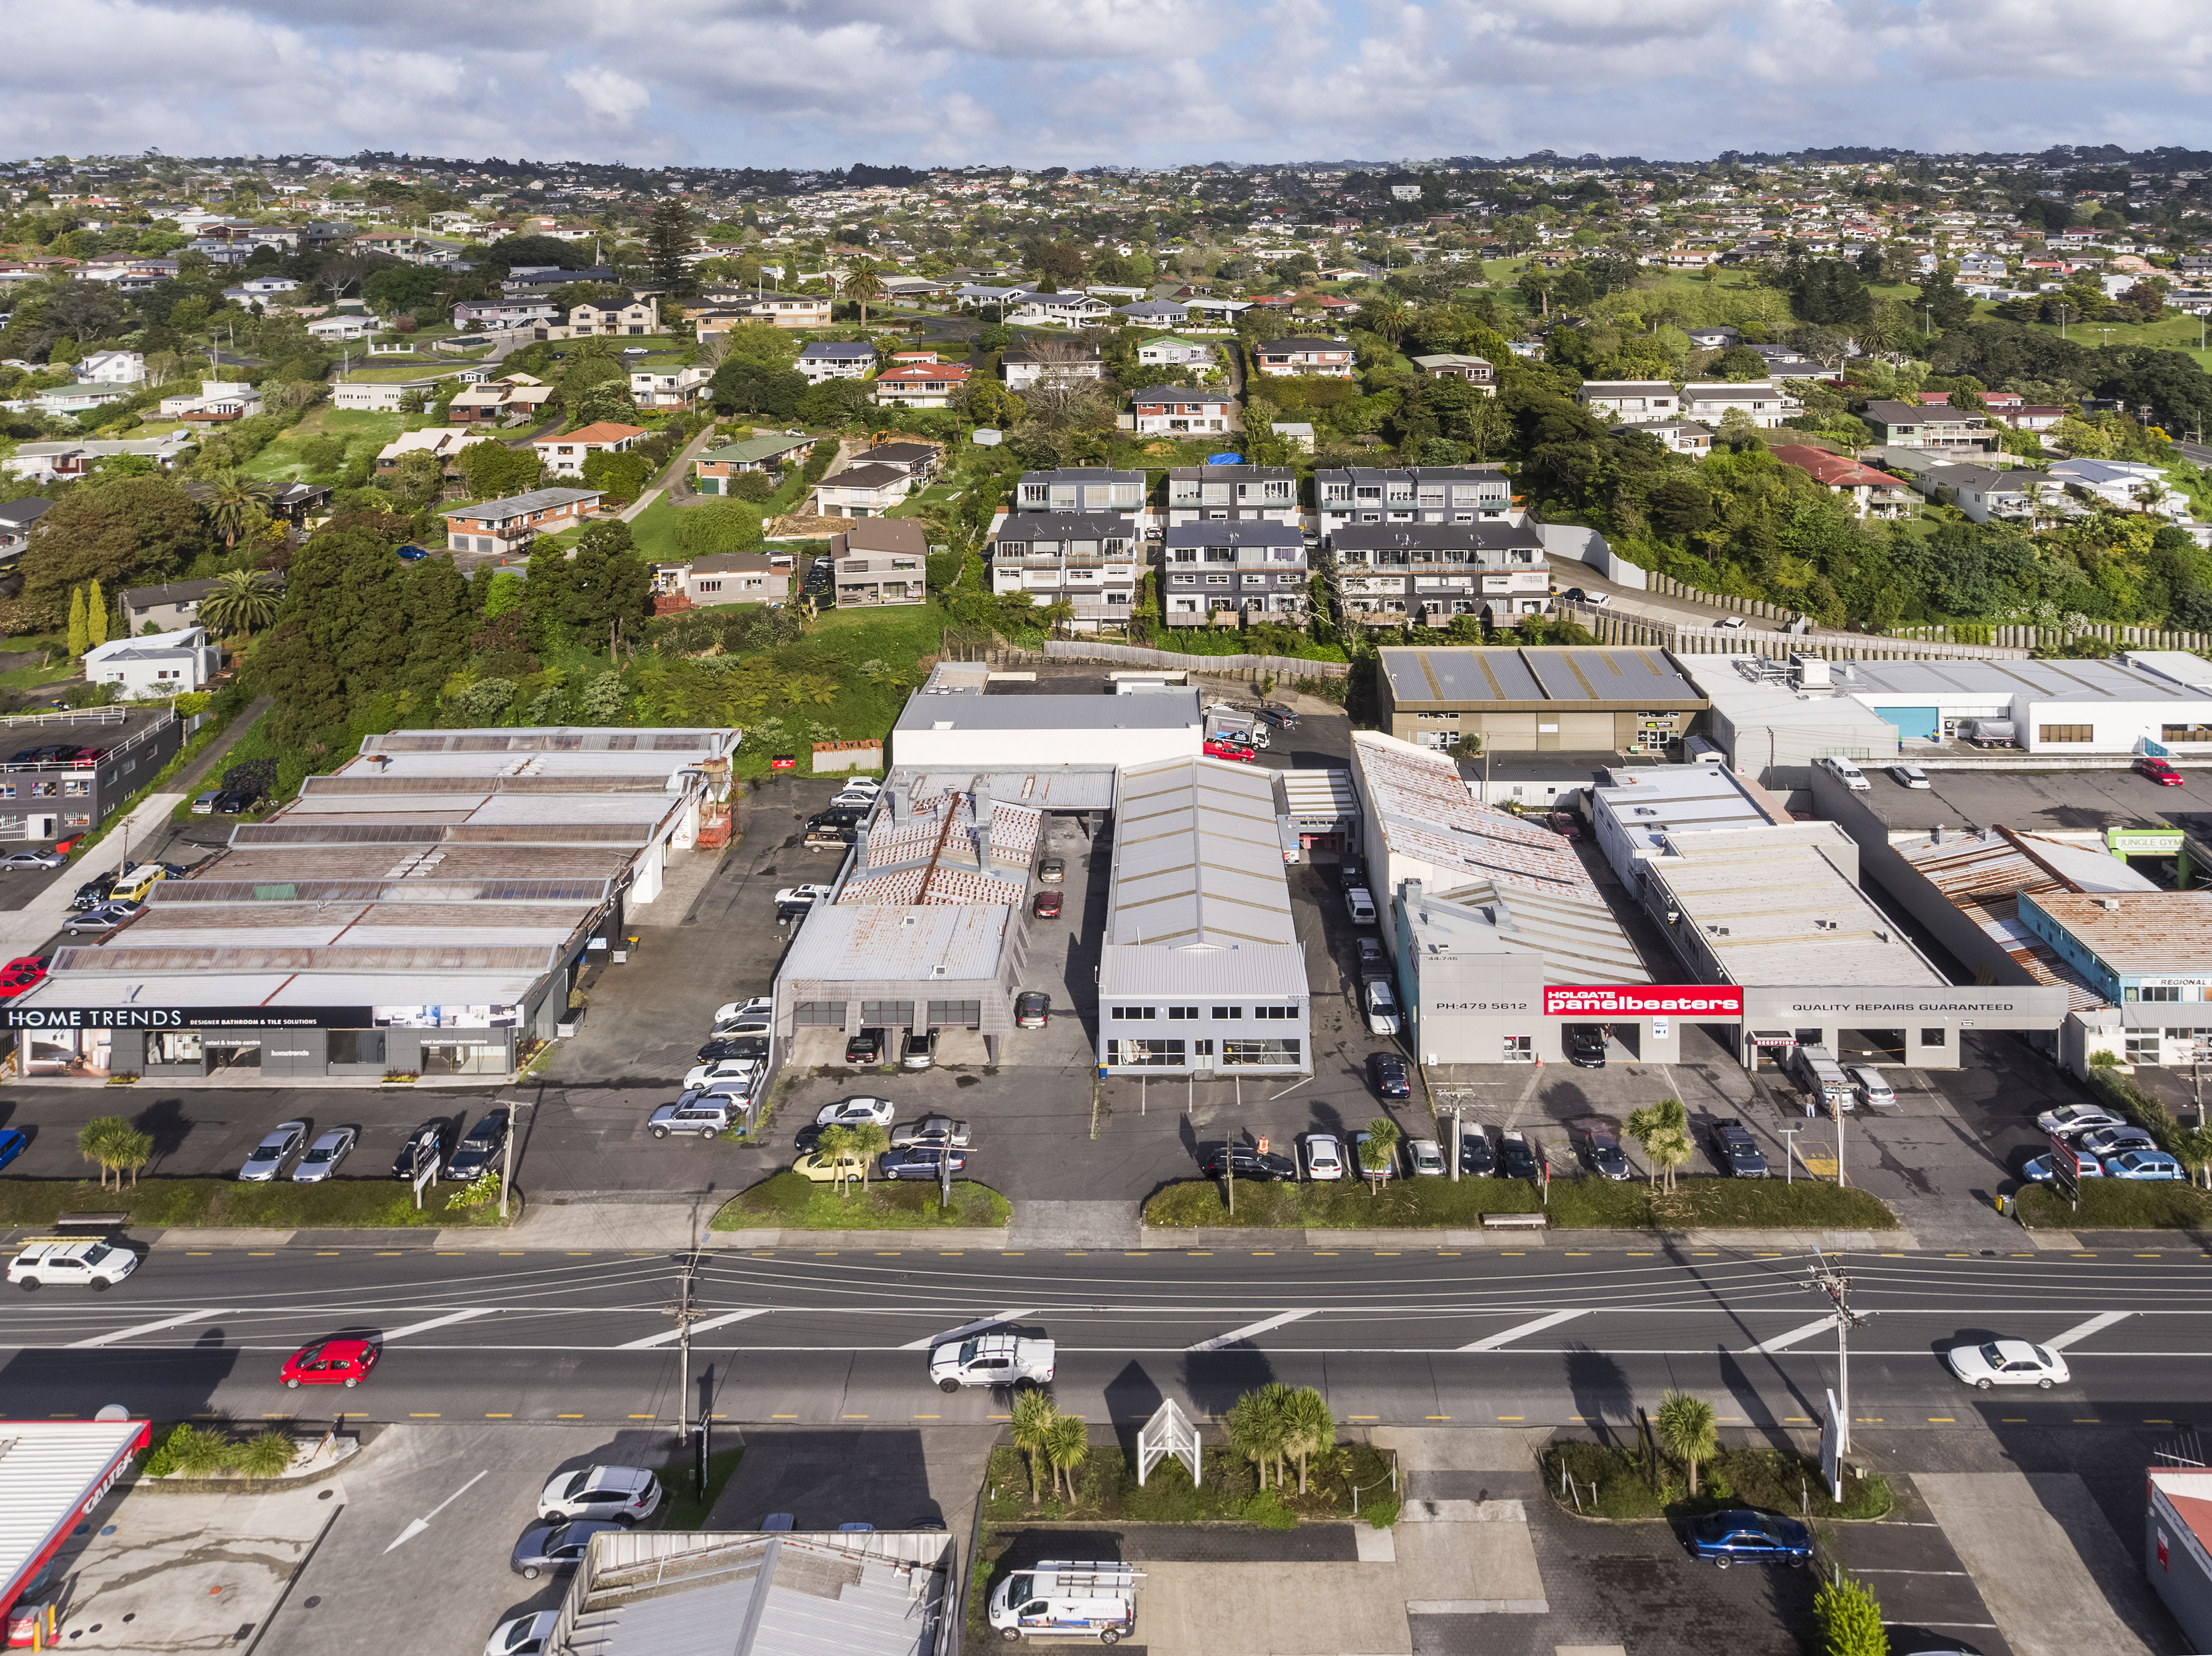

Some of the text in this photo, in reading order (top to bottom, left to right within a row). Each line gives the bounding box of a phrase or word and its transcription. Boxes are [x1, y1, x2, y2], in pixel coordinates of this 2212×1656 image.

[1548, 997, 1739, 1013] panelbeaters
[8, 1010, 181, 1026] HOME TRENDS
[81, 1448, 133, 1514] CALTEX
